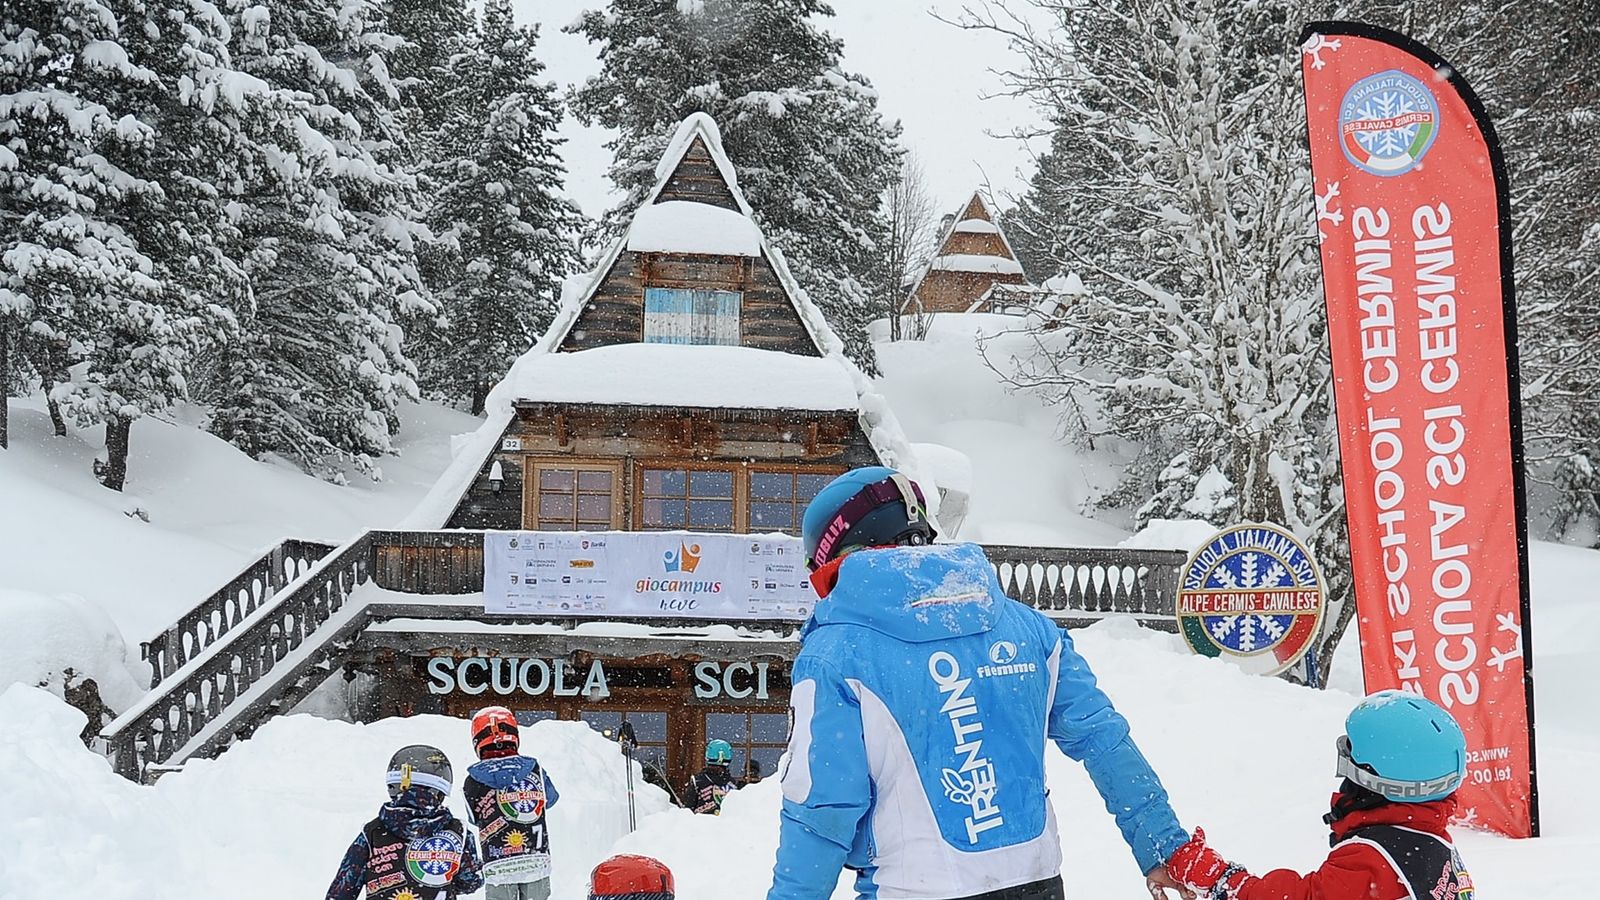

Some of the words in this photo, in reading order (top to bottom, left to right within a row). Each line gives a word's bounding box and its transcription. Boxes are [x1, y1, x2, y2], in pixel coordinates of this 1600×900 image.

[1184, 535, 1230, 590] SCUOLA
[1234, 529, 1297, 563] ITALIANA
[1293, 559, 1316, 588] SCI
[635, 577, 722, 594] giocampus
[1182, 594, 1210, 612] ALPE
[427, 656, 610, 698] SCUOLA
[694, 661, 769, 699] SCI
[927, 650, 1004, 845] TRENTINO
[531, 823, 543, 850] 7
